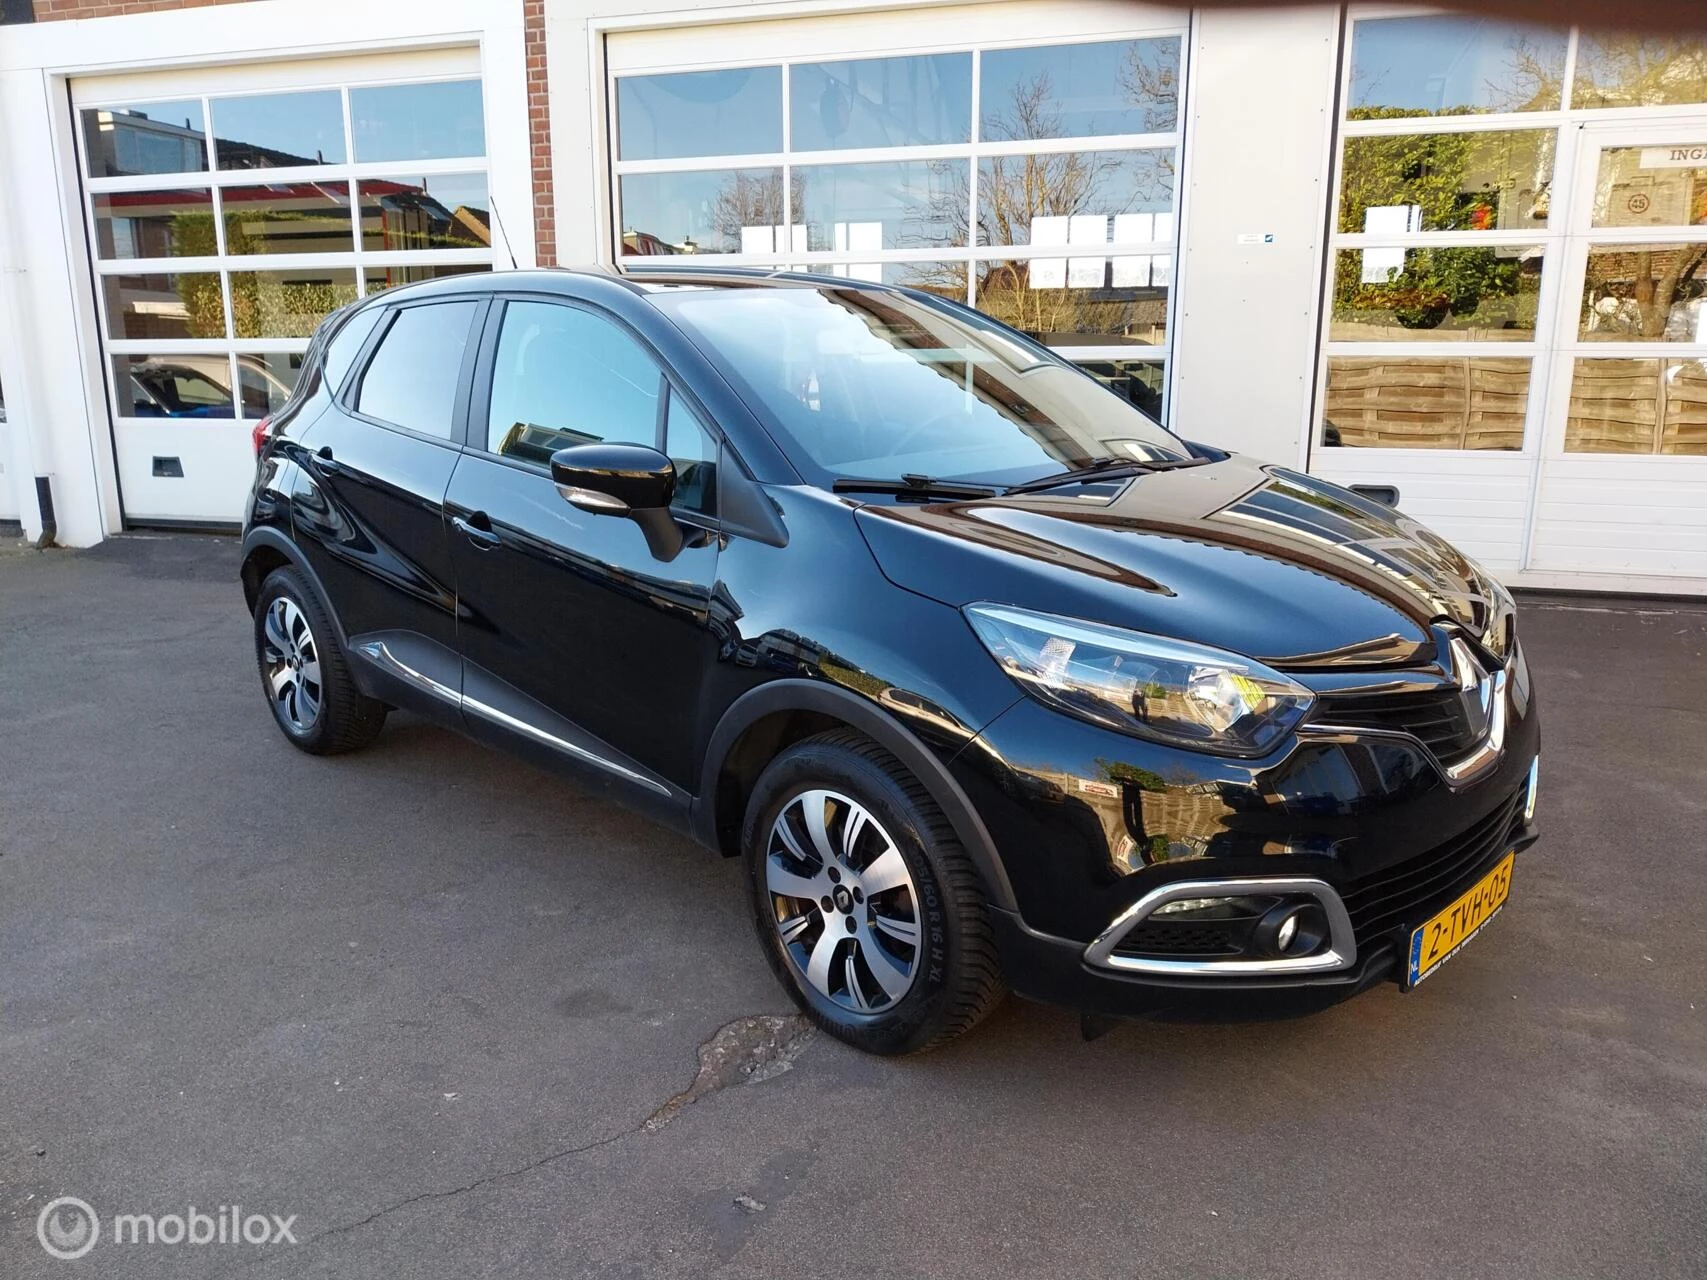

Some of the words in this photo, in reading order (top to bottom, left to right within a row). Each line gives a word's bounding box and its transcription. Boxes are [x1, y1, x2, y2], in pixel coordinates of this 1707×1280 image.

[1631, 198, 1646, 210] 45
[1427, 863, 1509, 961] 2-TVH-05
[1410, 959, 1419, 975] NL
